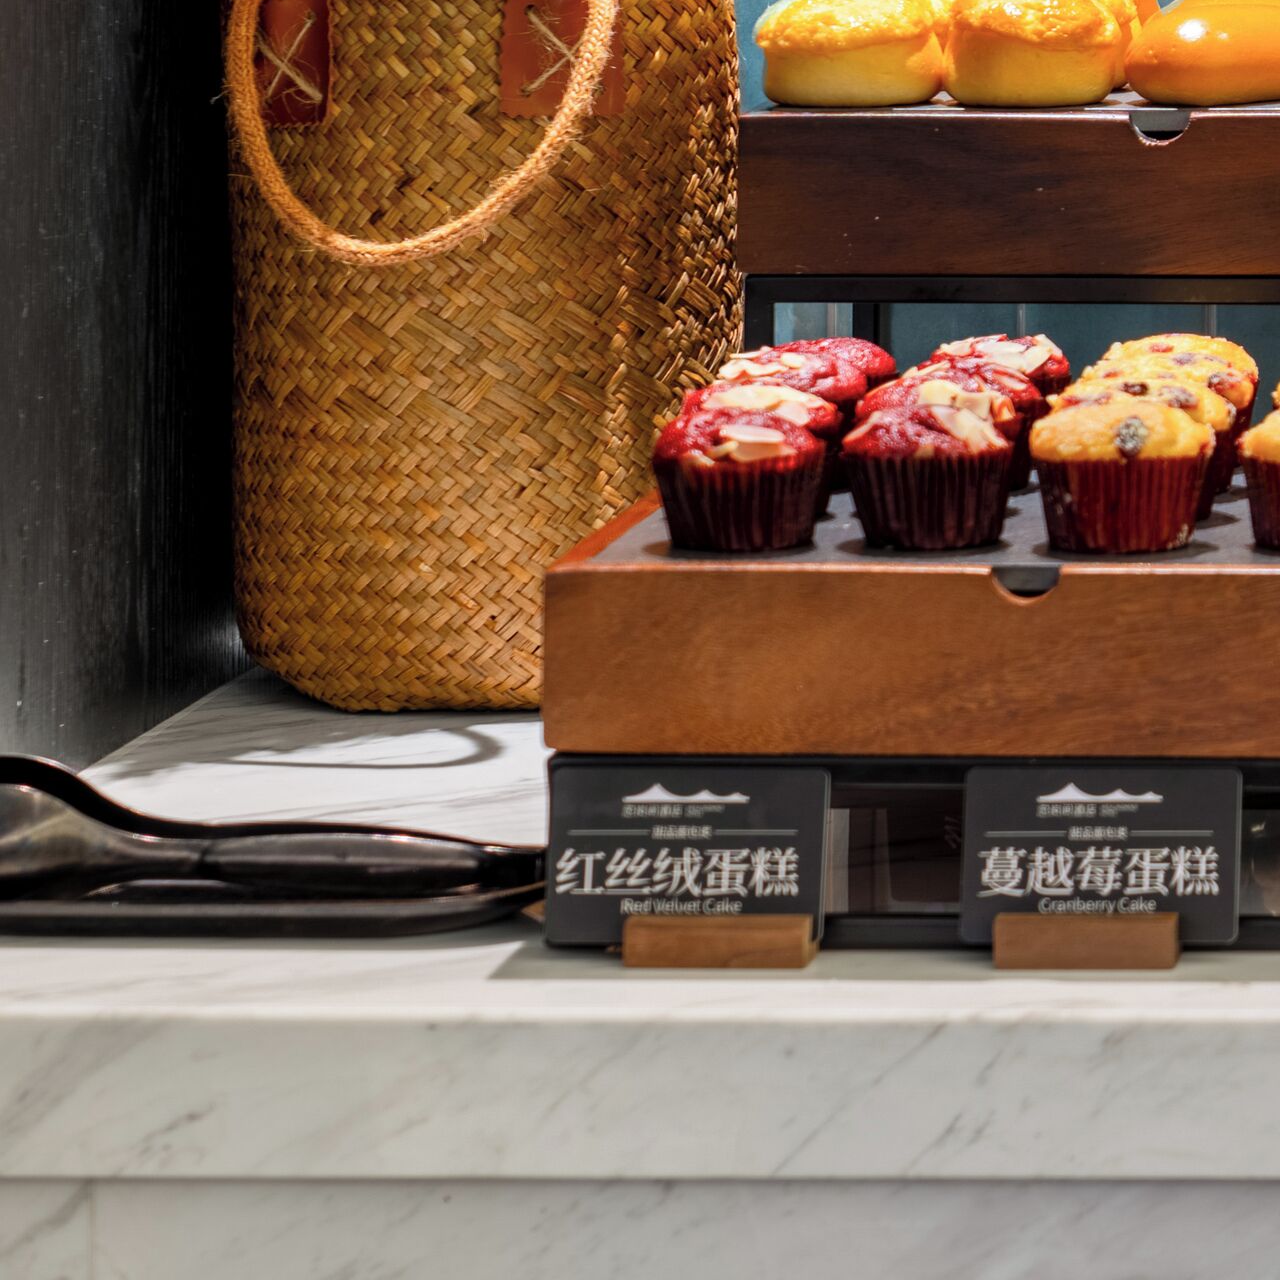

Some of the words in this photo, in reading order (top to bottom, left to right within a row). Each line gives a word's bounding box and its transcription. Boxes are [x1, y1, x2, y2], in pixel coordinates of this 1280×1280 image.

[555, 847, 799, 897] 红丝绒蛋糕
[976, 846, 1220, 897] 蔓越莓蛋糕
[621, 898, 651, 914] Red
[654, 897, 701, 914] Velvet
[703, 897, 742, 913] Cake
[1038, 896, 1116, 915] Cranberry
[1118, 896, 1157, 912] Cake
